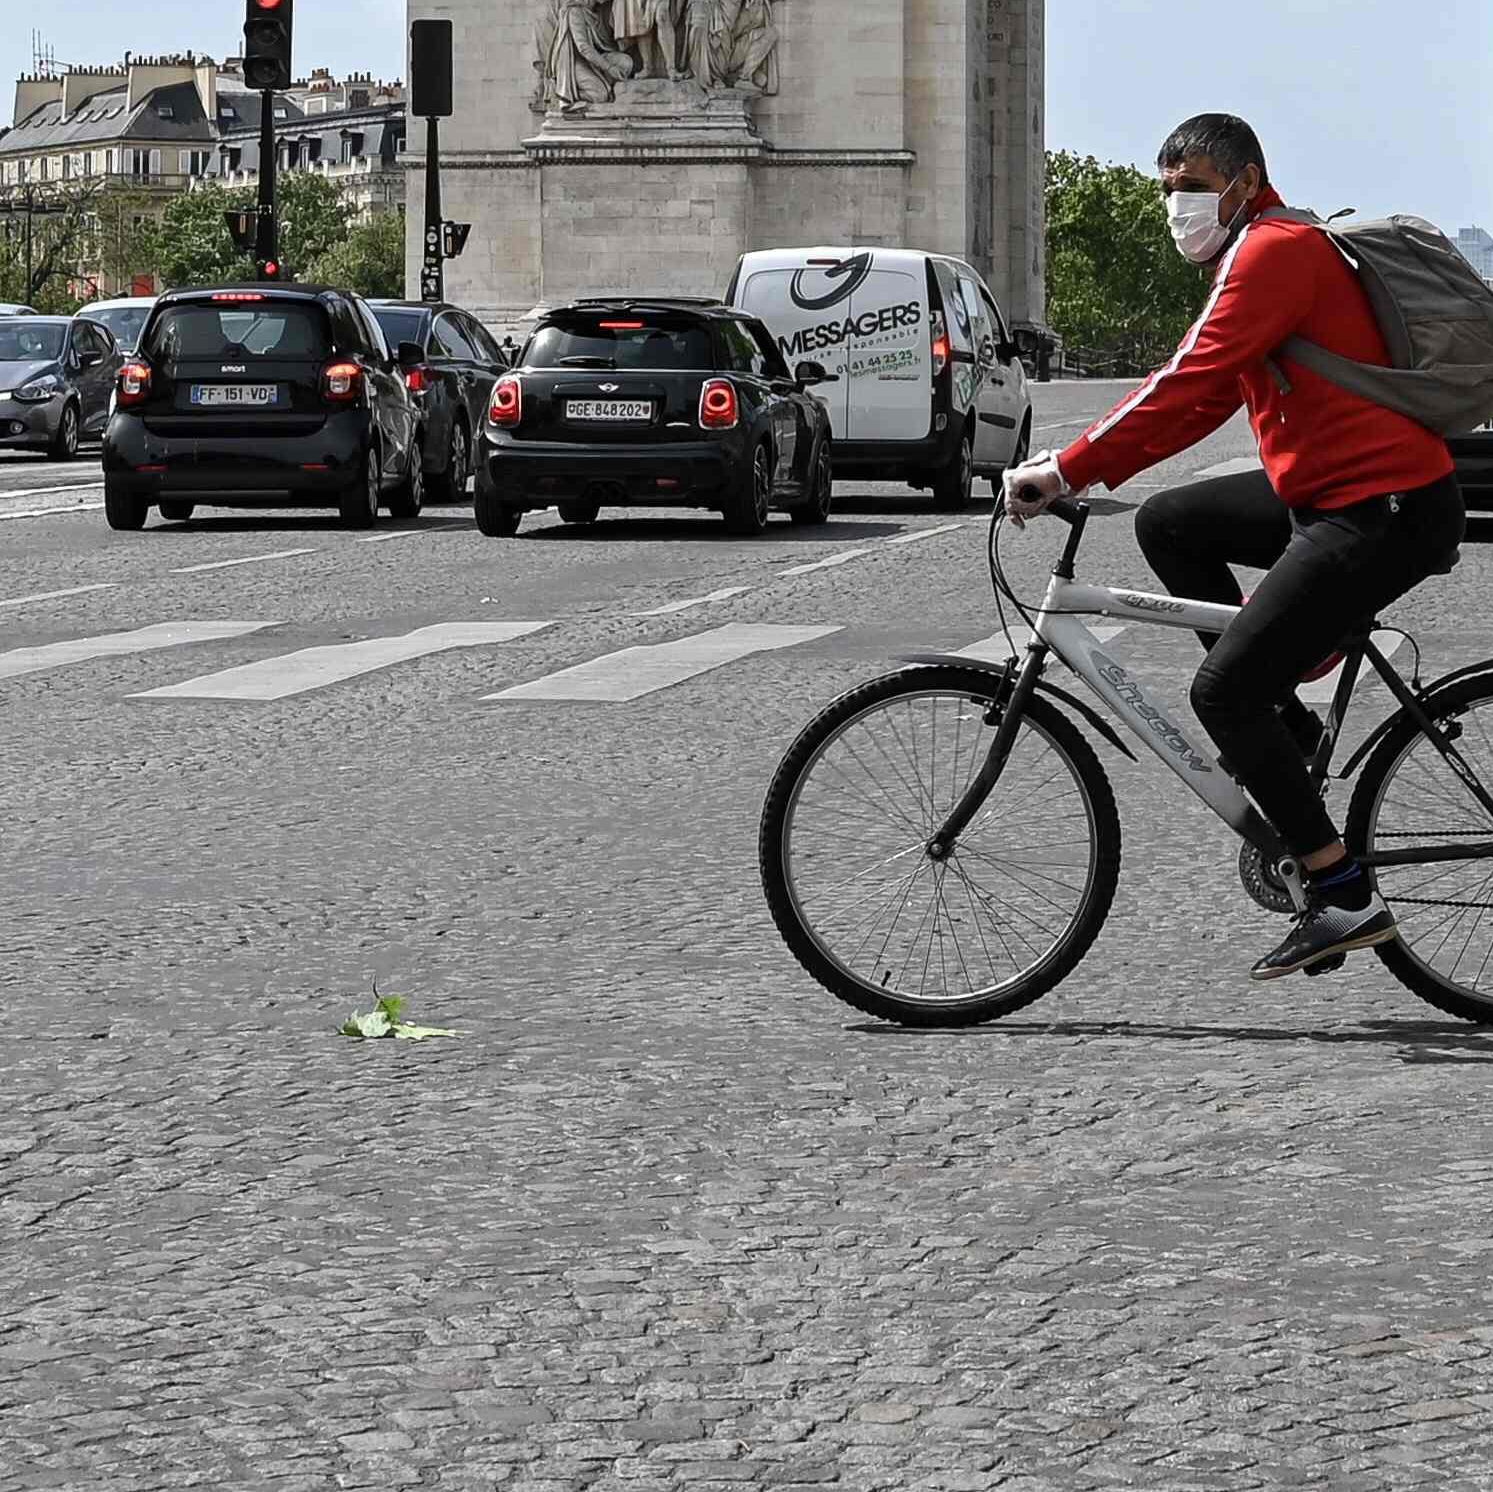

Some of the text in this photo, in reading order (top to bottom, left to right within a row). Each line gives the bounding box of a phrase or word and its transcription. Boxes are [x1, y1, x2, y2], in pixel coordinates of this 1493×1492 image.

[777, 301, 921, 357] MESSAGERS
[851, 360, 864, 370] 41
[868, 356, 881, 367] 44
[883, 353, 897, 364] 25
[899, 349, 913, 360] 25
